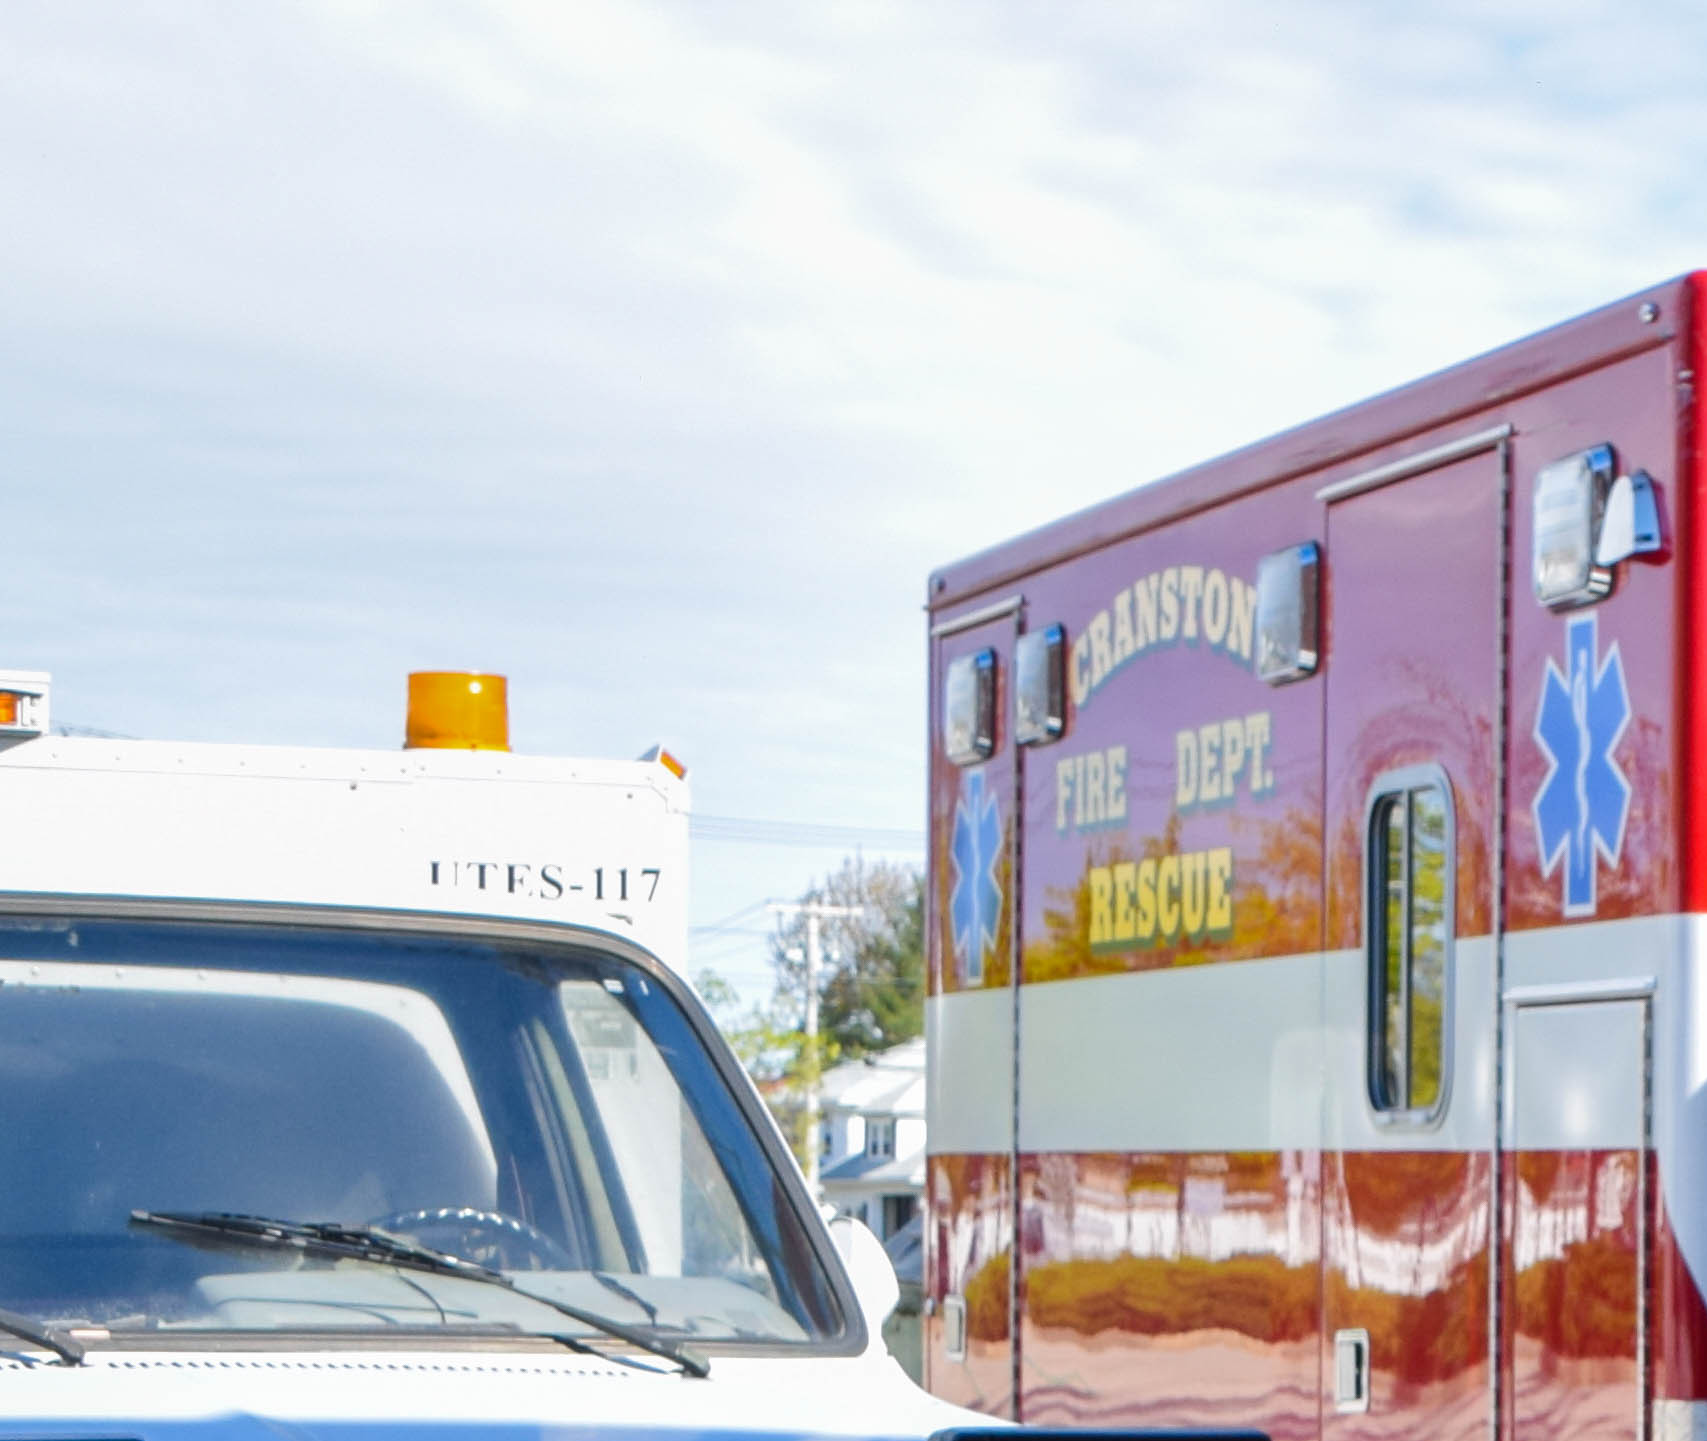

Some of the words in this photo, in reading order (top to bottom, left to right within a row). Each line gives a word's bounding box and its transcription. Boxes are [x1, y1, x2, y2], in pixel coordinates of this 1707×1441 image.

[1069, 565, 1259, 706] CRANSTON
[1056, 745, 1128, 832] FIRE
[1176, 712, 1274, 808] DEPT.
[429, 860, 662, 902] UTES-117
[1089, 846, 1232, 946] RESCUE
